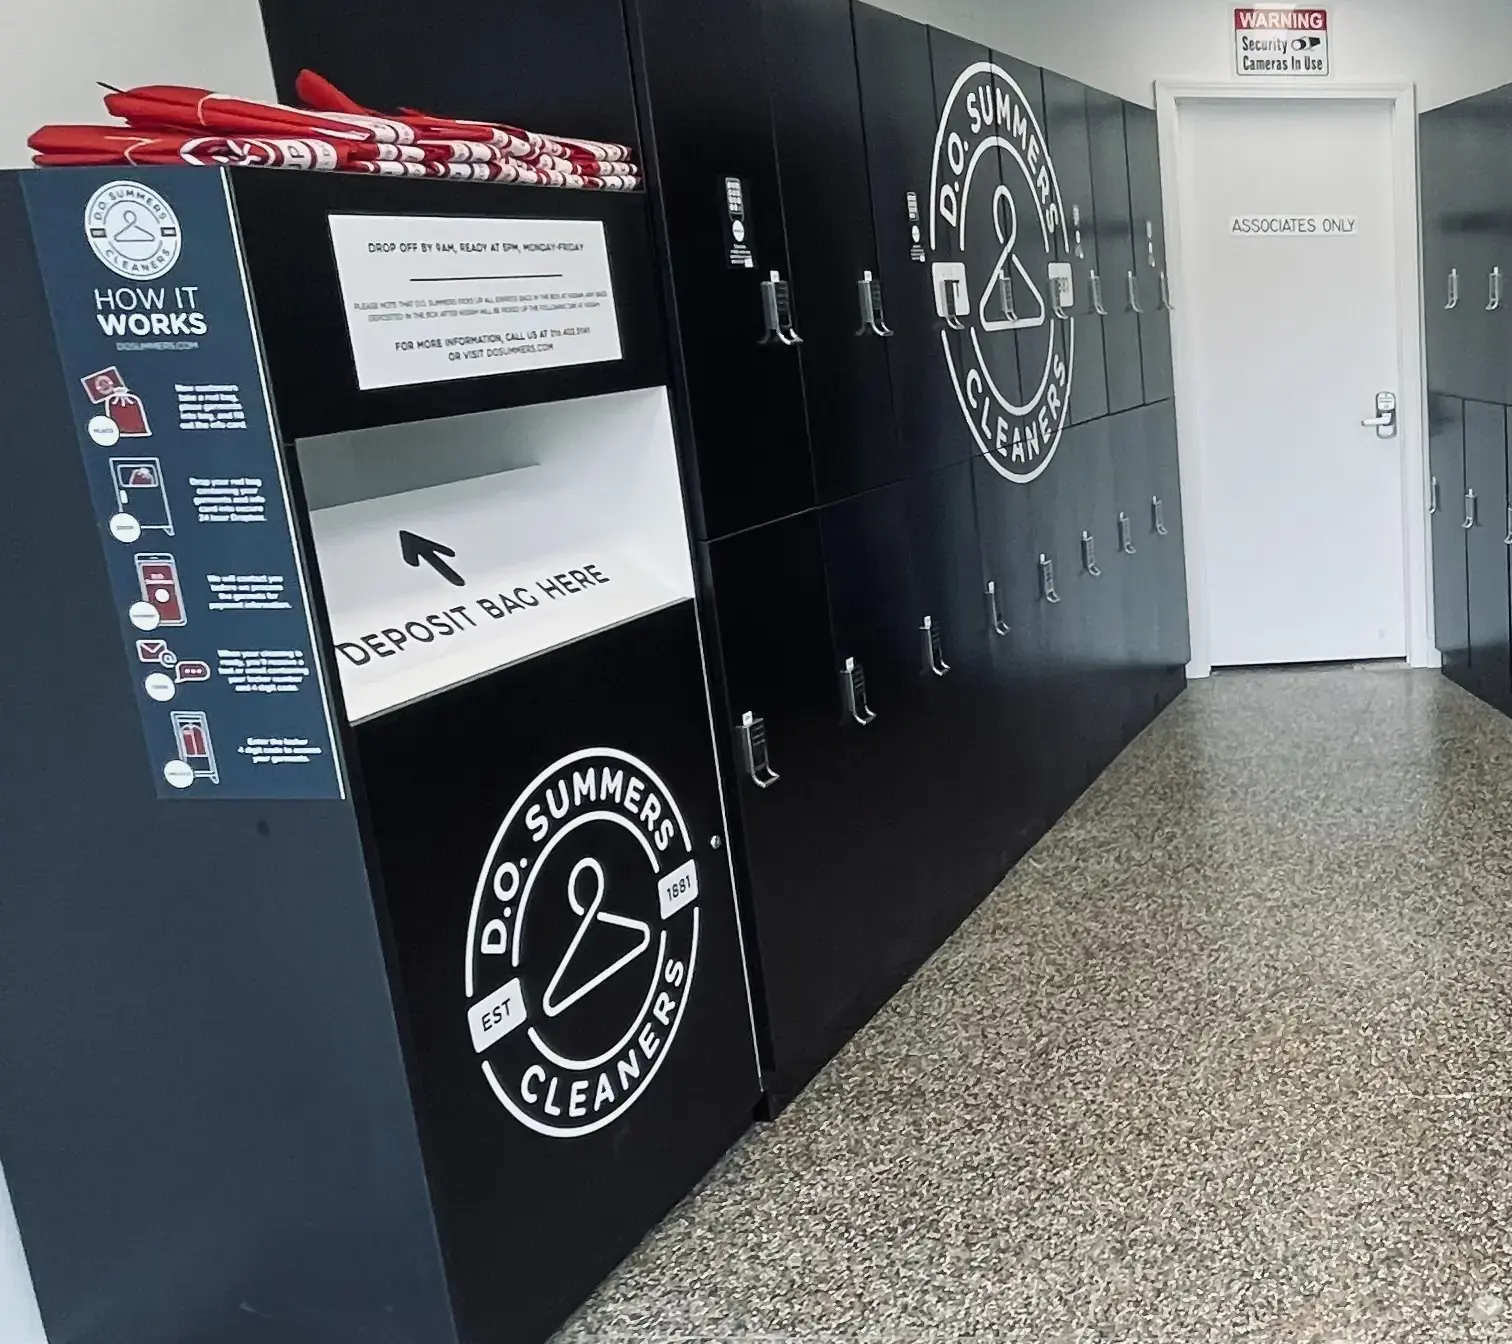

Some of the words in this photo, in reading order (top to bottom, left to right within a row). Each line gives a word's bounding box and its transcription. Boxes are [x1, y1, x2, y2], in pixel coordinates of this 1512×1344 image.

[1239, 11, 1323, 29] WARNING
[1242, 35, 1288, 55] Security
[1243, 55, 1288, 71] Cameras
[1291, 55, 1301, 71] In
[1304, 55, 1323, 71] Use
[939, 131, 970, 227] D.O.
[965, 85, 1059, 234] SUMMERS
[108, 188, 168, 221] SUMMERS
[1231, 218, 1317, 233] ASSOCIATES
[1322, 218, 1355, 233] ONLY
[367, 242, 397, 253] DROP
[399, 242, 418, 253] OFF
[421, 242, 433, 253] BY
[460, 242, 488, 253] READY
[490, 242, 500, 253] AT
[105, 248, 171, 272] CLEANERS
[93, 287, 165, 311] HOW
[174, 286, 199, 310] IT
[96, 312, 209, 336] WORKS
[394, 341, 414, 352] FOR
[416, 338, 443, 350] MORE
[444, 333, 504, 347] INFORMATION,
[505, 331, 526, 342] CALL
[526, 330, 538, 340] US
[540, 329, 548, 339] AT
[447, 351, 461, 362] OR
[463, 348, 483, 360] VISIT
[965, 354, 1067, 464] CLEANERS
[334, 605, 478, 667] DEPOSIT
[475, 587, 540, 620] BAG
[535, 563, 611, 600] HERE
[480, 856, 529, 955] D.O.
[524, 766, 676, 852] SUMMERS
[665, 873, 693, 903] 1881
[480, 997, 512, 1032] EST
[520, 957, 685, 1117] CLEANERS
